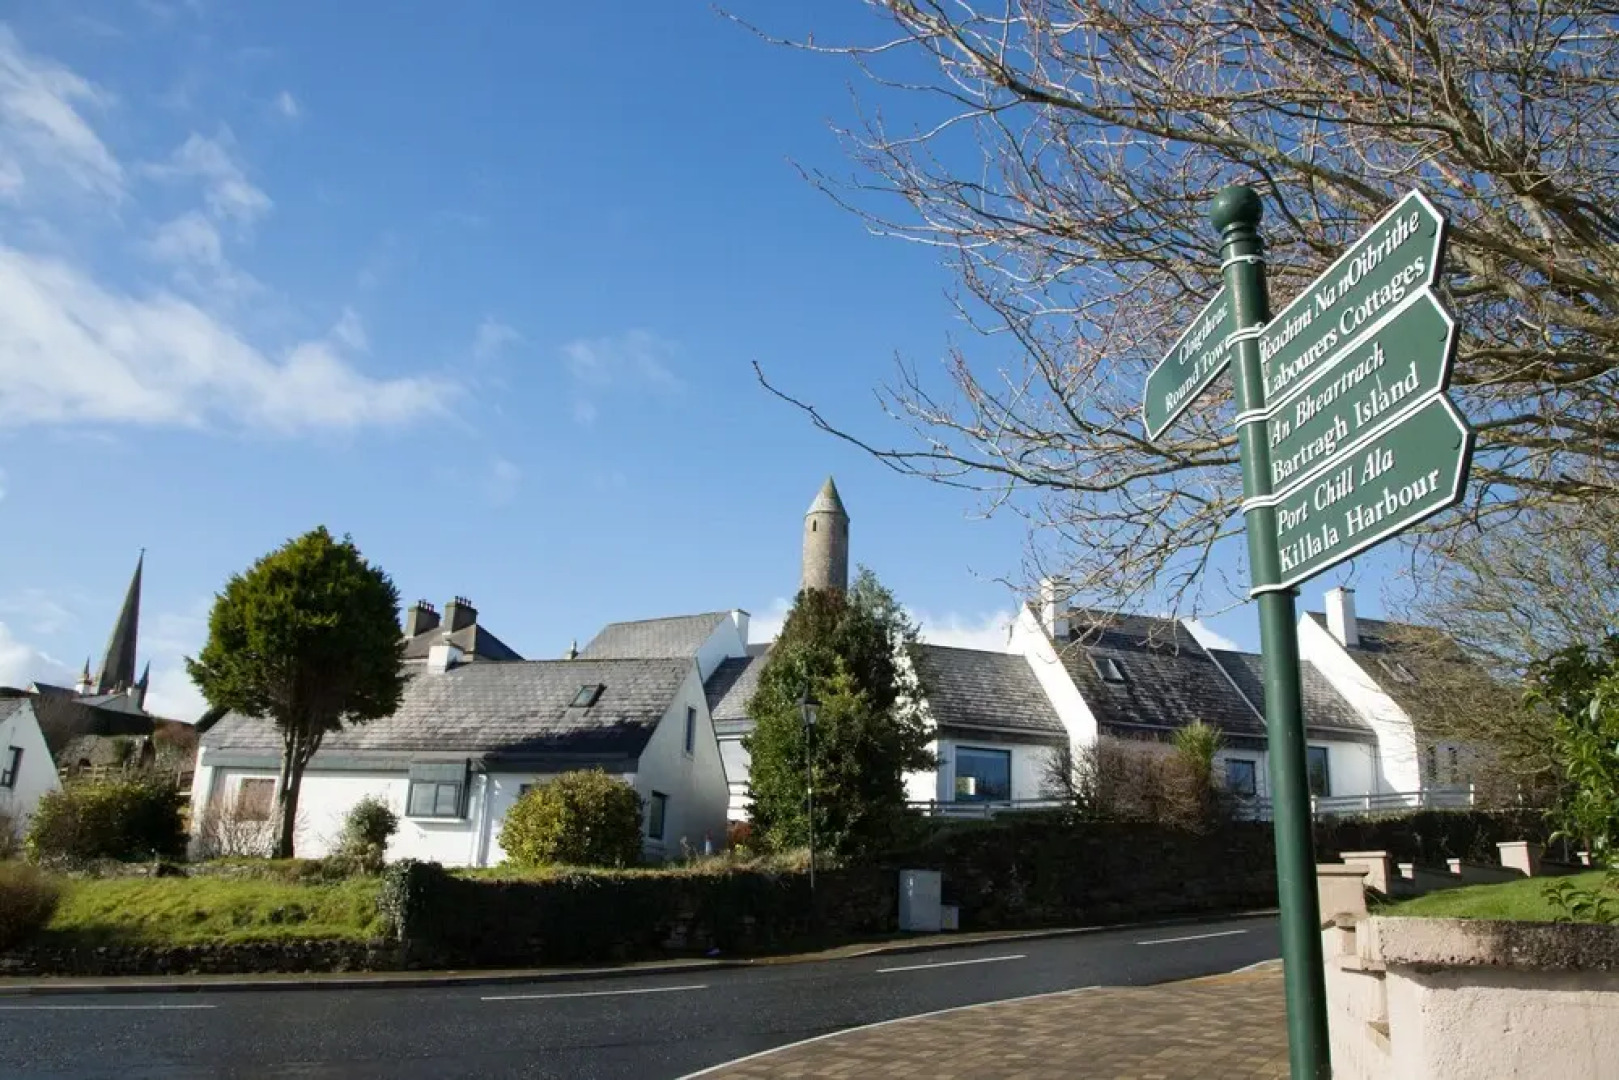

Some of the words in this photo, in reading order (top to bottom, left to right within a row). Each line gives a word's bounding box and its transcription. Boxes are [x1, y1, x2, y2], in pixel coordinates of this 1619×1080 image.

[1314, 286, 1335, 319] Na
[1338, 211, 1420, 297] nOibrithe
[1165, 361, 1199, 413] Round
[1200, 340, 1225, 374] Tow
[1264, 327, 1338, 398] Labourers
[1339, 255, 1425, 335] Cottages
[1271, 421, 1290, 448] An
[1295, 341, 1385, 428] Bheartrach
[1272, 415, 1348, 485] Bartragh
[1354, 361, 1419, 428] Island
[1277, 500, 1308, 536] Port
[1314, 465, 1354, 511] Chill
[1360, 449, 1395, 486] Ala
[1280, 523, 1340, 572] Killala
[1345, 467, 1440, 537] Harbour
